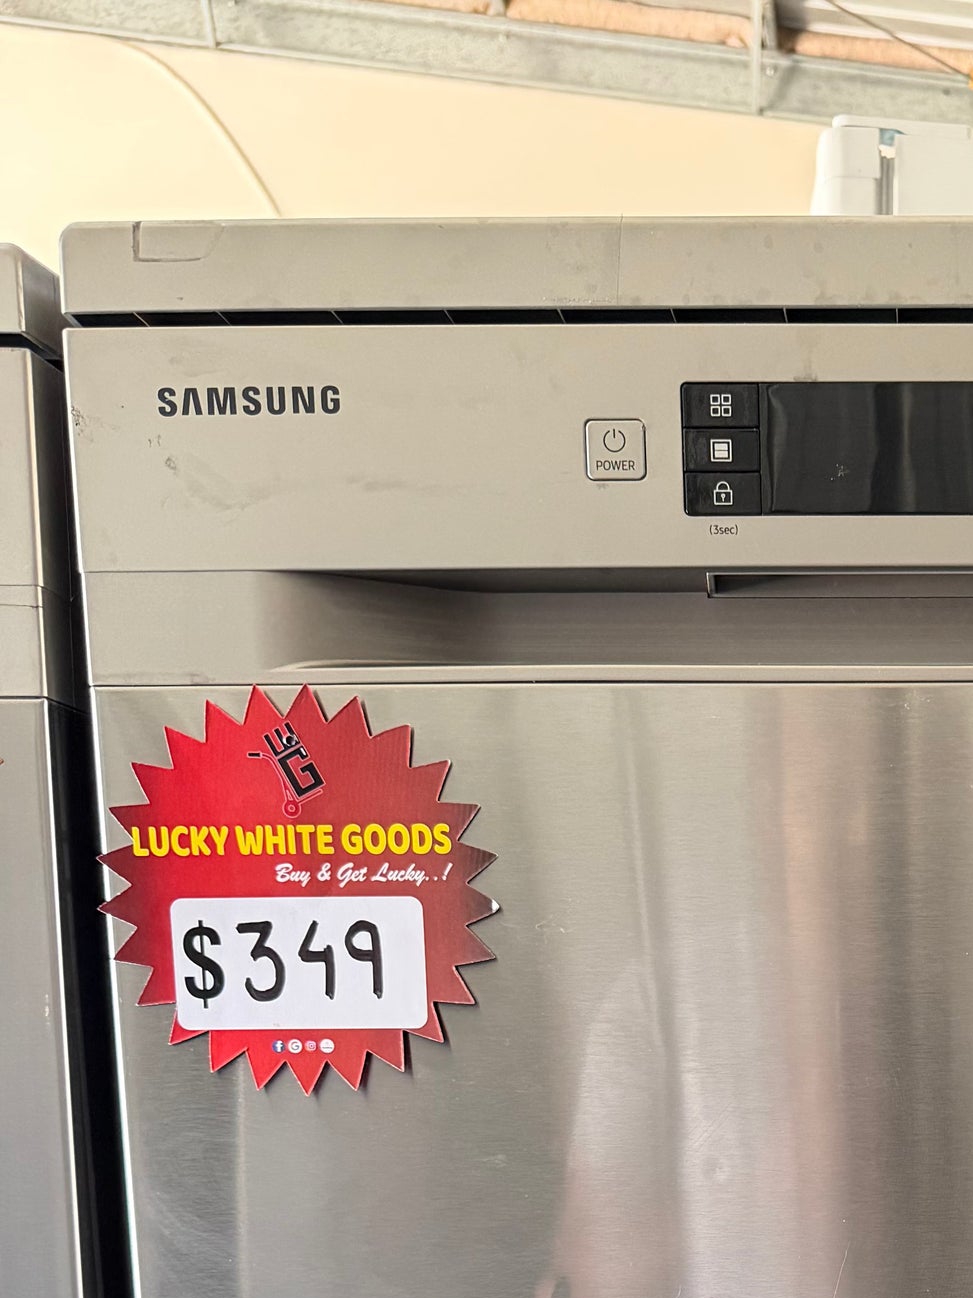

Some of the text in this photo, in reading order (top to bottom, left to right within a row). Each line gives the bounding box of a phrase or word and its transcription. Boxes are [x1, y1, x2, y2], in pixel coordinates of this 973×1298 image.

[157, 385, 341, 417] SAMSUNG
[596, 460, 636, 471] POWER
[709, 524, 738, 536] (3sec)
[131, 823, 452, 858] LUCKY WHITE GOODS
[274, 864, 311, 887] Buy
[316, 865, 333, 881] &
[336, 863, 367, 888] Get
